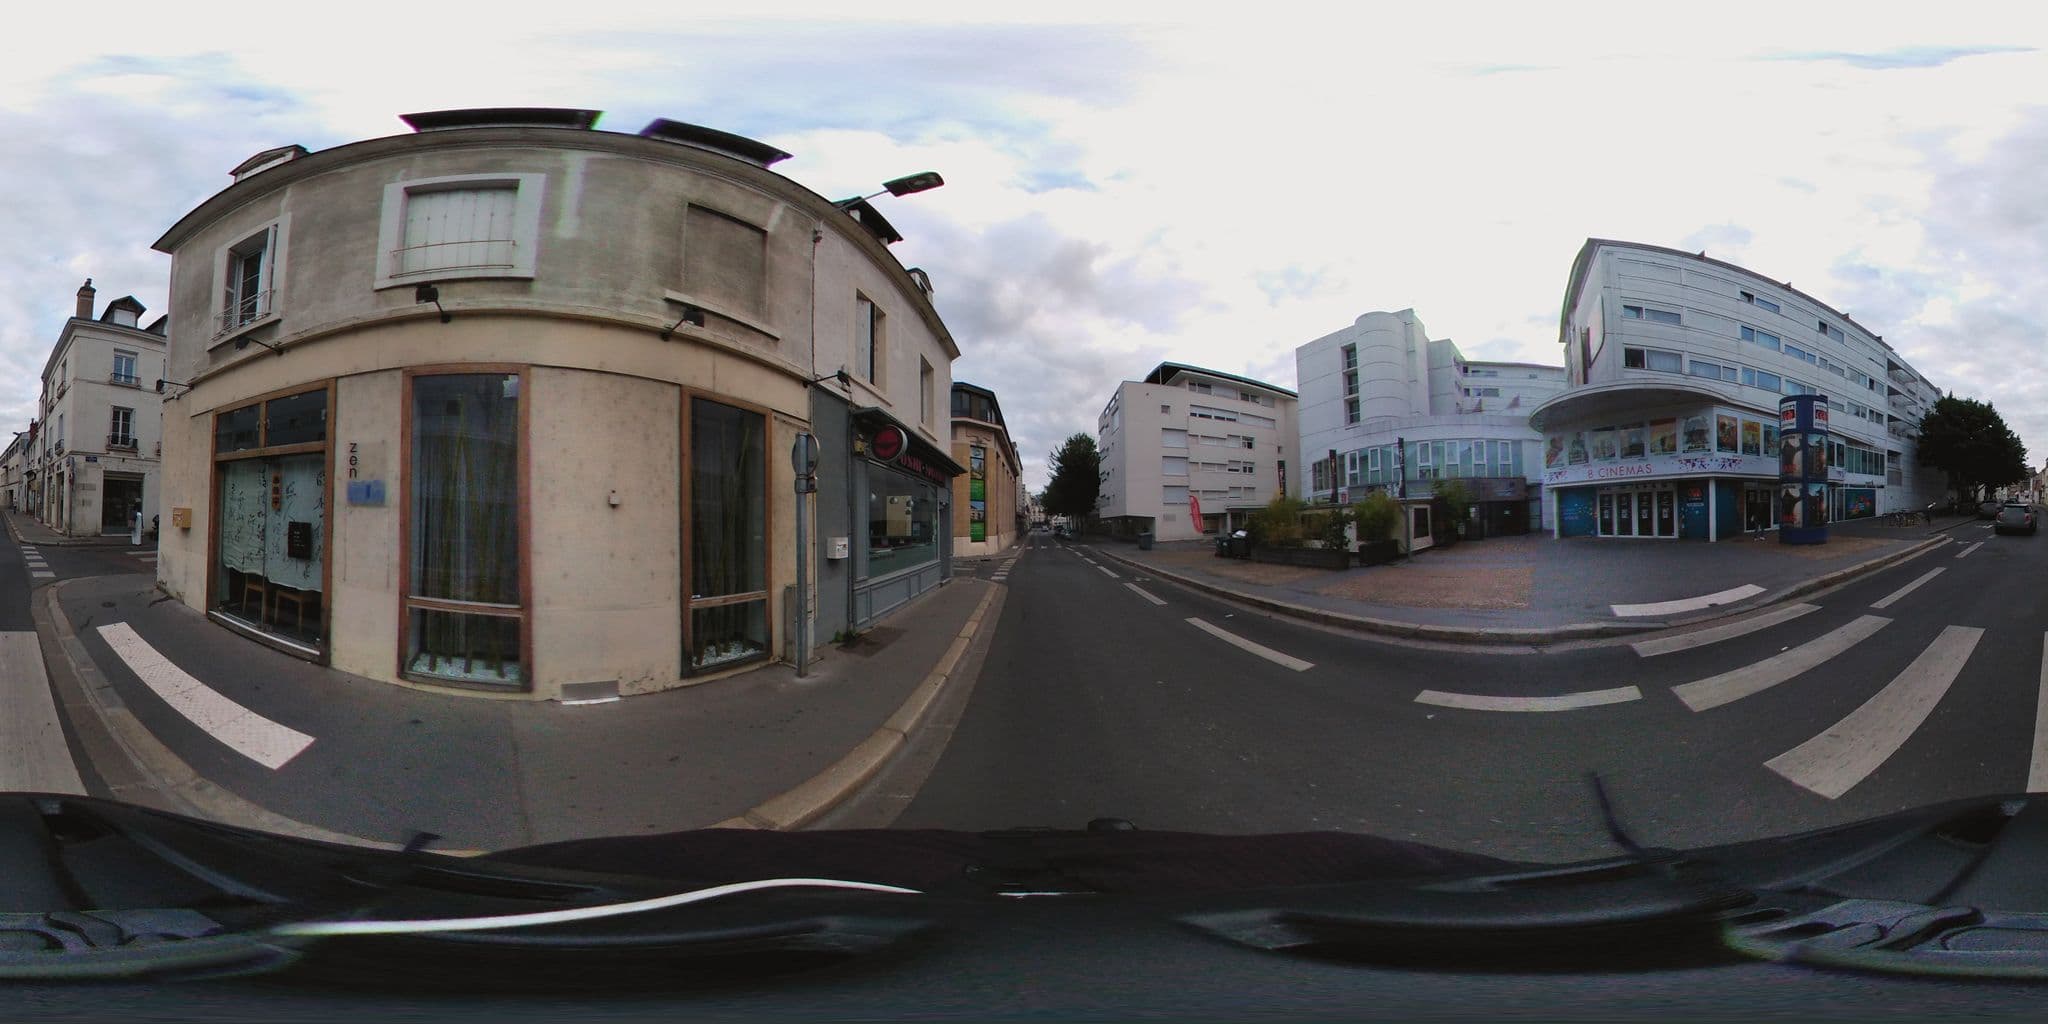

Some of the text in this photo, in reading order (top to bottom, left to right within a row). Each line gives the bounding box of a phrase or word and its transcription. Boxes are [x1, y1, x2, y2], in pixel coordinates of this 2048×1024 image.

[349, 443, 358, 478] zen
[1587, 463, 1653, 479] 8 CINEMAS
